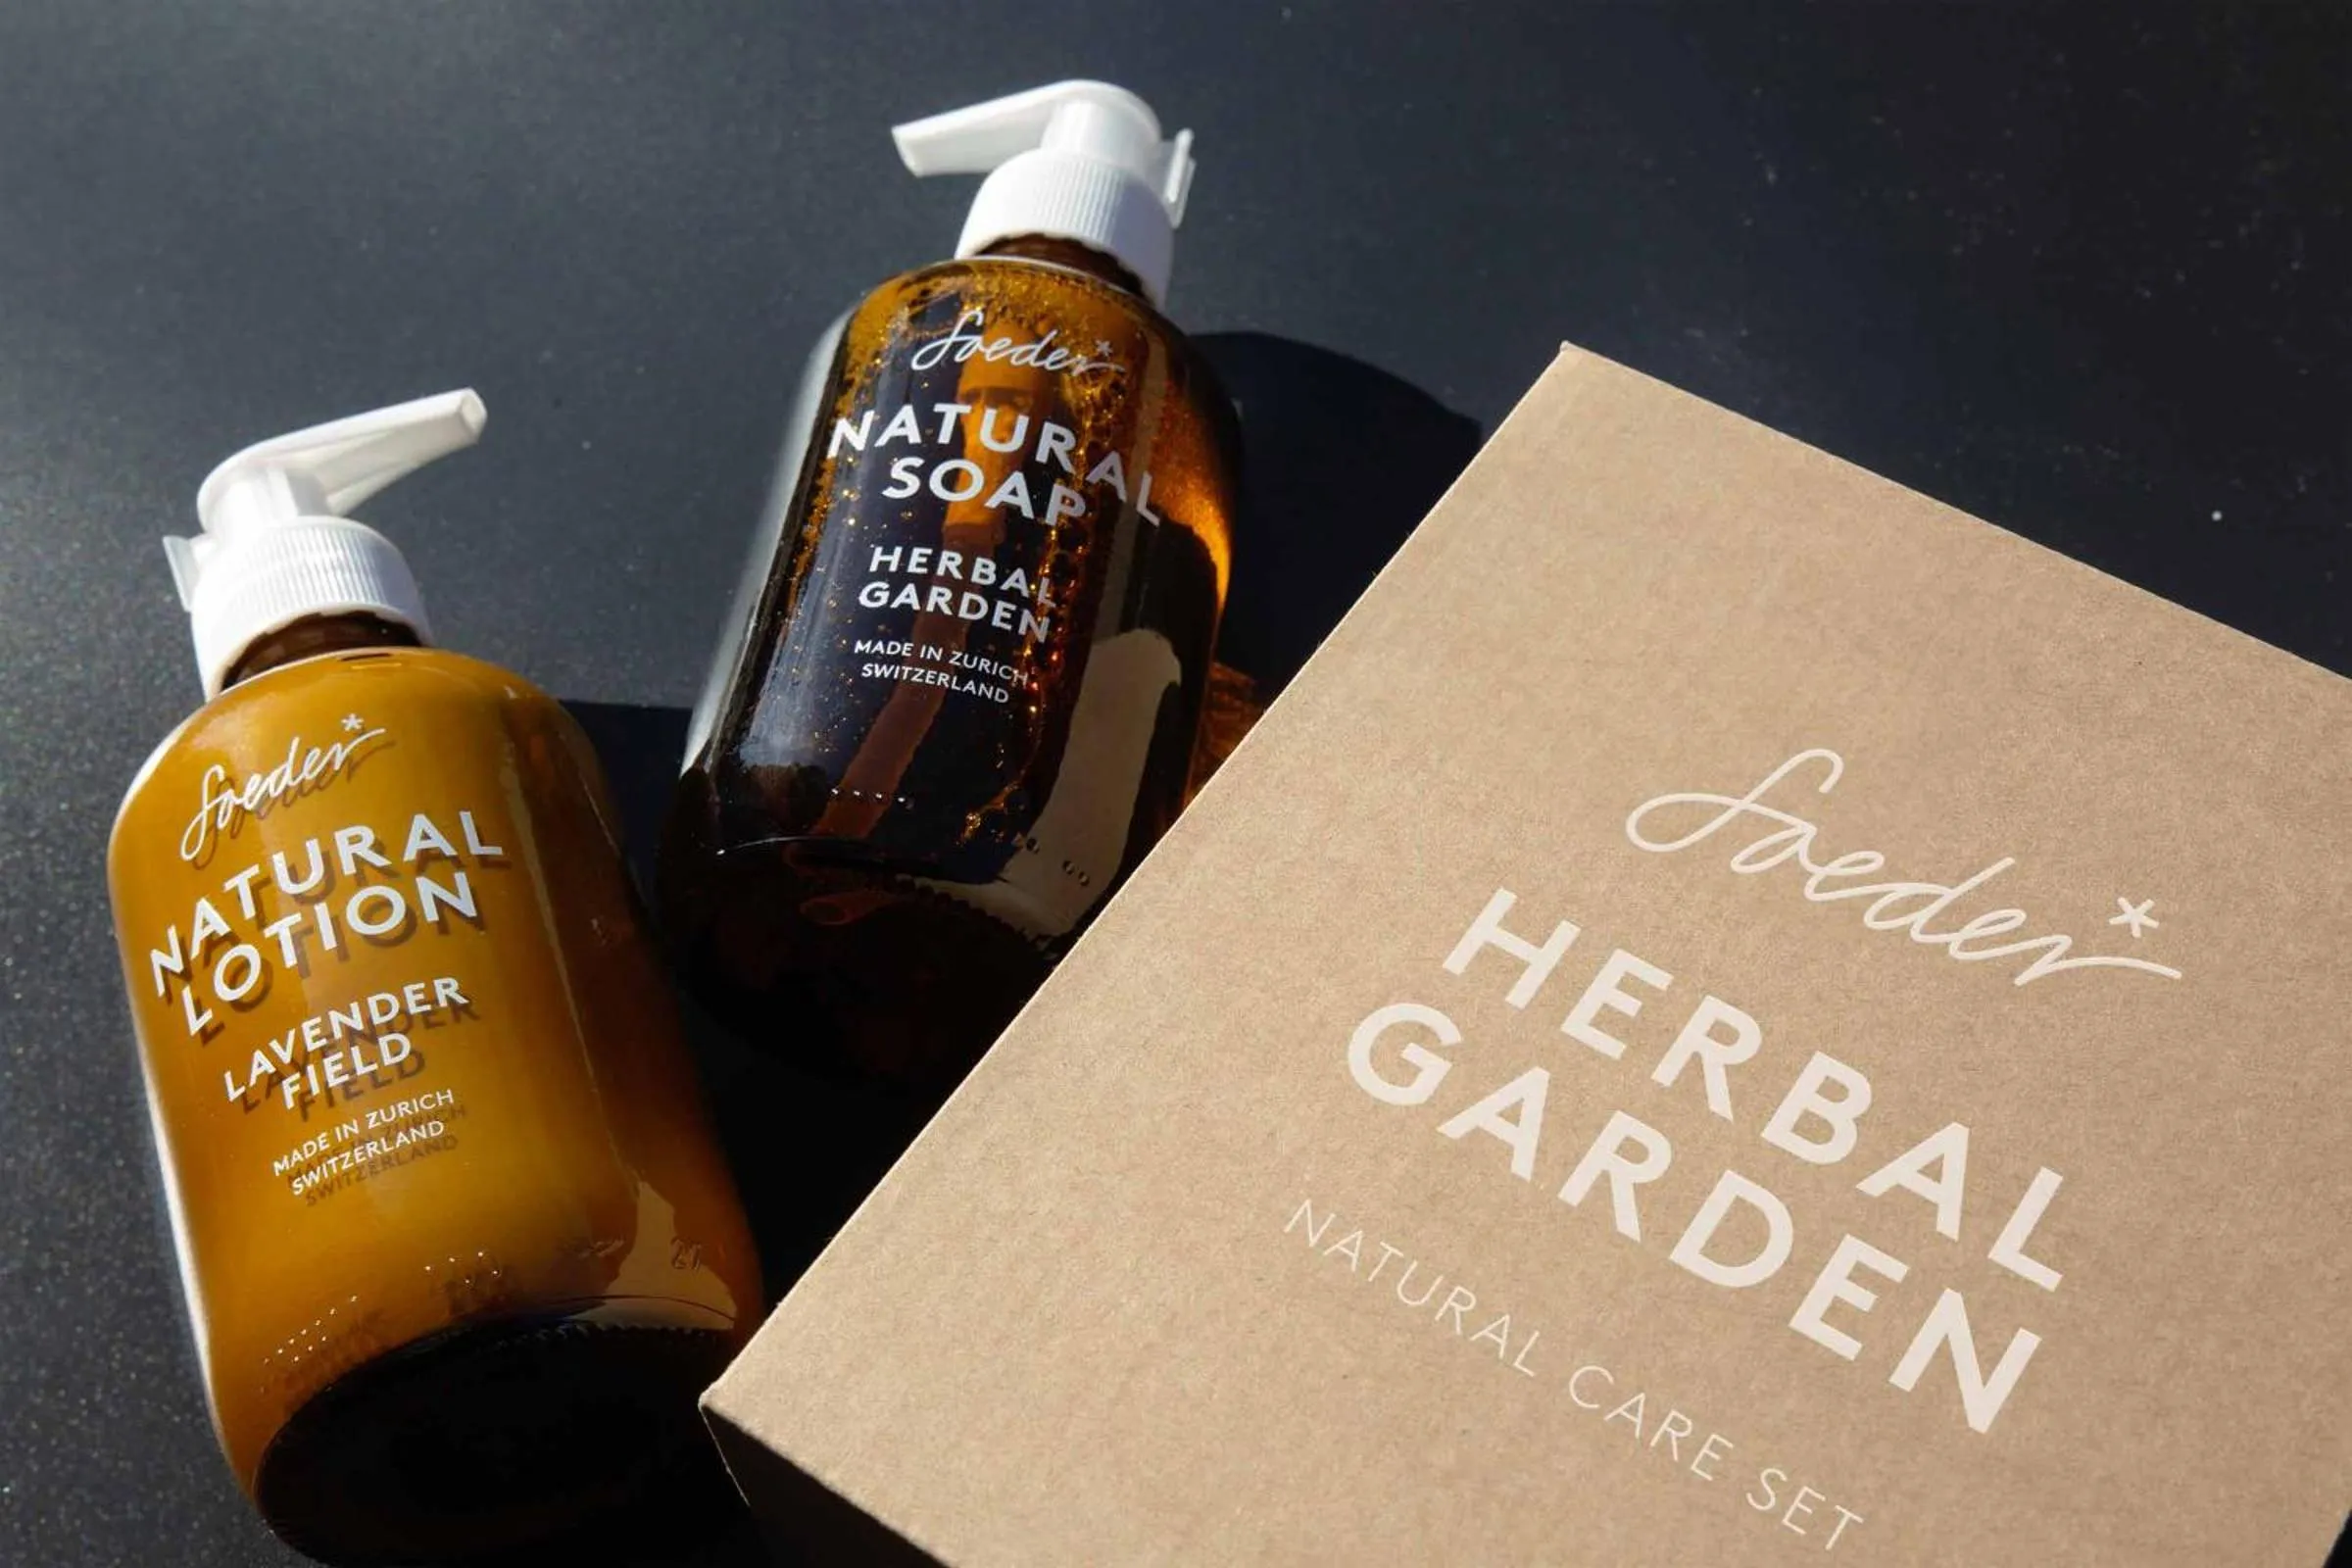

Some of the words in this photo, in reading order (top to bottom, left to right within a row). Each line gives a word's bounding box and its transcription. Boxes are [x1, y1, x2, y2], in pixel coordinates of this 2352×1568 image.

[826, 402, 1161, 527] NATURAL
[881, 455, 1087, 527] SOAP
[858, 580, 1051, 644] GARDEN
[868, 545, 1056, 609] HERBAL
[854, 639, 914, 657] MADE
[919, 644, 944, 662] IN
[948, 650, 1029, 688] ZURICH
[860, 662, 1010, 704] SWITZERLAND
[149, 809, 504, 998] NATURAL
[179, 870, 478, 1037] LOTION
[222, 976, 469, 1102] LAVENDER
[281, 1031, 413, 1110] FIELD
[272, 1132, 331, 1177] MADE
[334, 1118, 361, 1143] IN
[365, 1088, 455, 1130] ZURICH
[1442, 886, 2064, 1293] HERBAL
[291, 1119, 446, 1197] SWITZERLAND
[1347, 1001, 2042, 1434] GARDEN
[1283, 1199, 1548, 1377] NATURAL
[1568, 1364, 1735, 1482] CARE
[1745, 1466, 1865, 1551] SET
